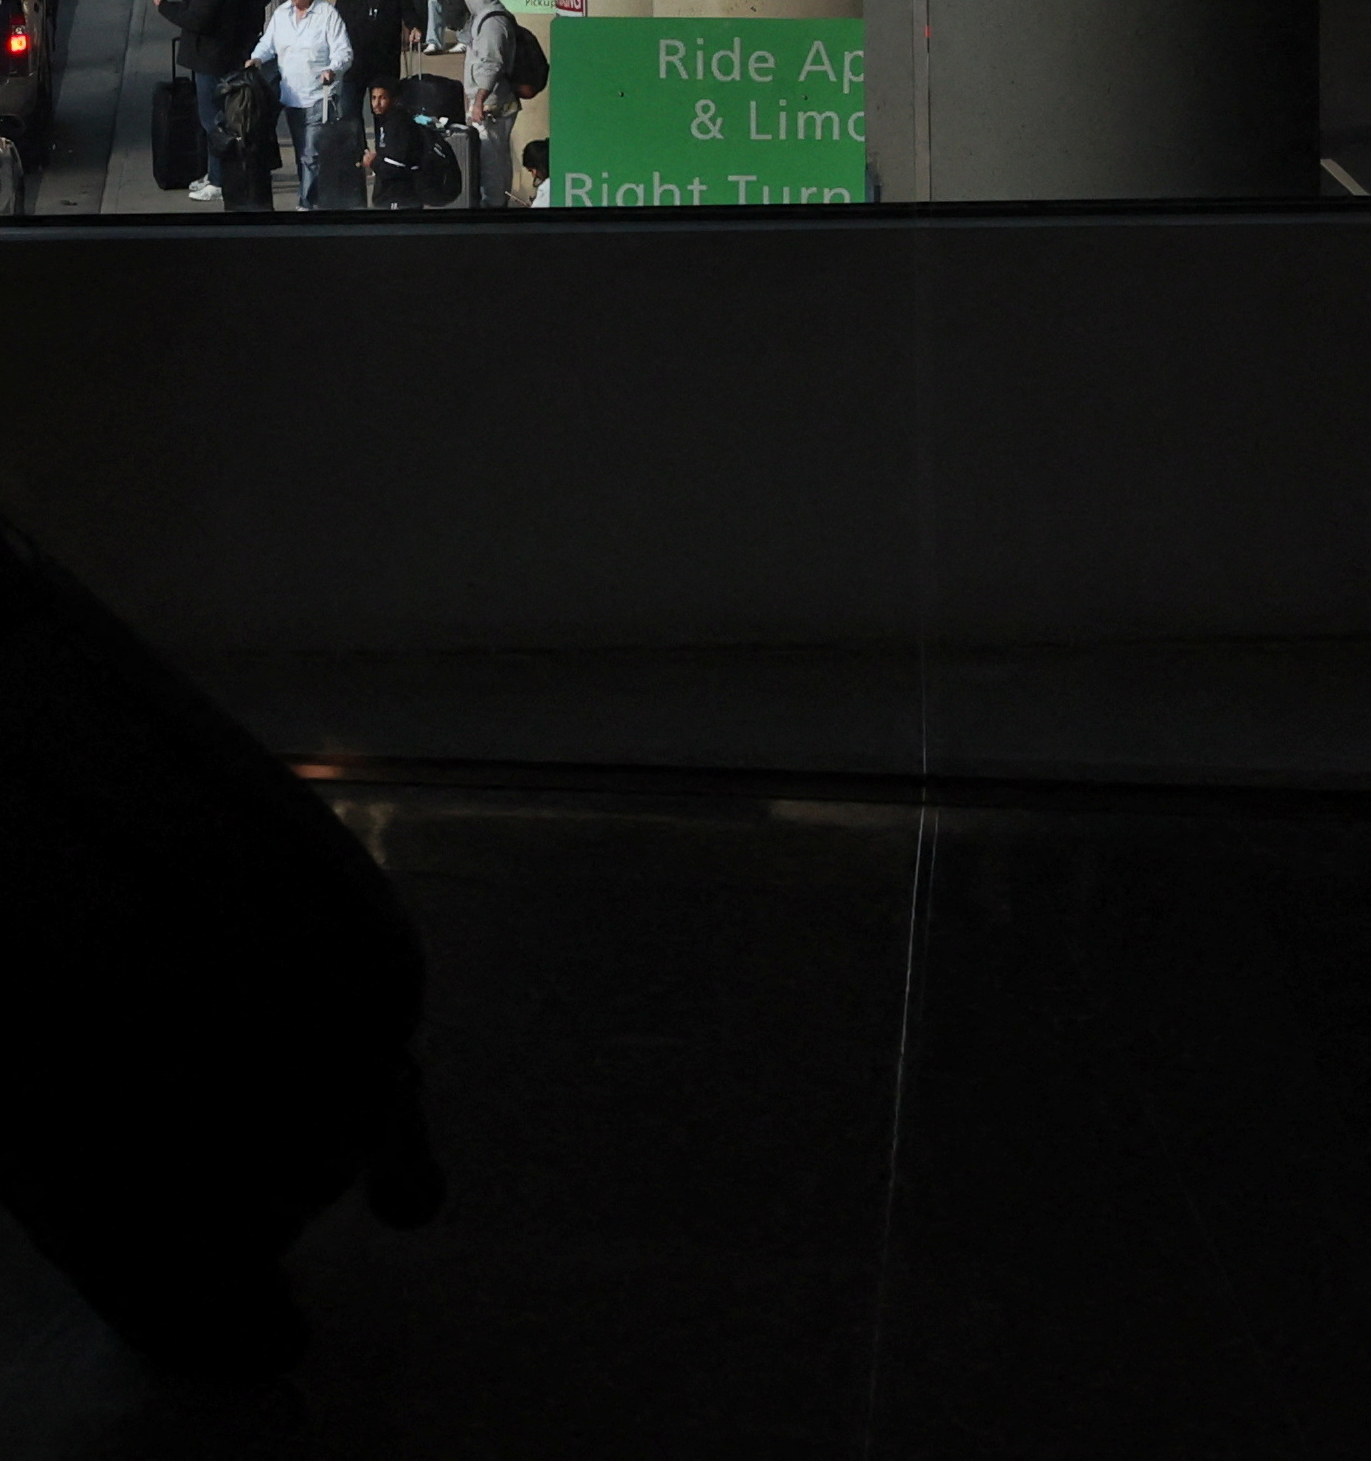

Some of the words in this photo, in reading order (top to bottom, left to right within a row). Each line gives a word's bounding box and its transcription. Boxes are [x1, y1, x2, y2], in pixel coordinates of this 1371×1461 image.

[659, 37, 775, 82] Ride
[798, 40, 865, 94] Ap
[690, 99, 725, 140] &
[564, 172, 708, 207] Right
[728, 175, 852, 205] Turn
